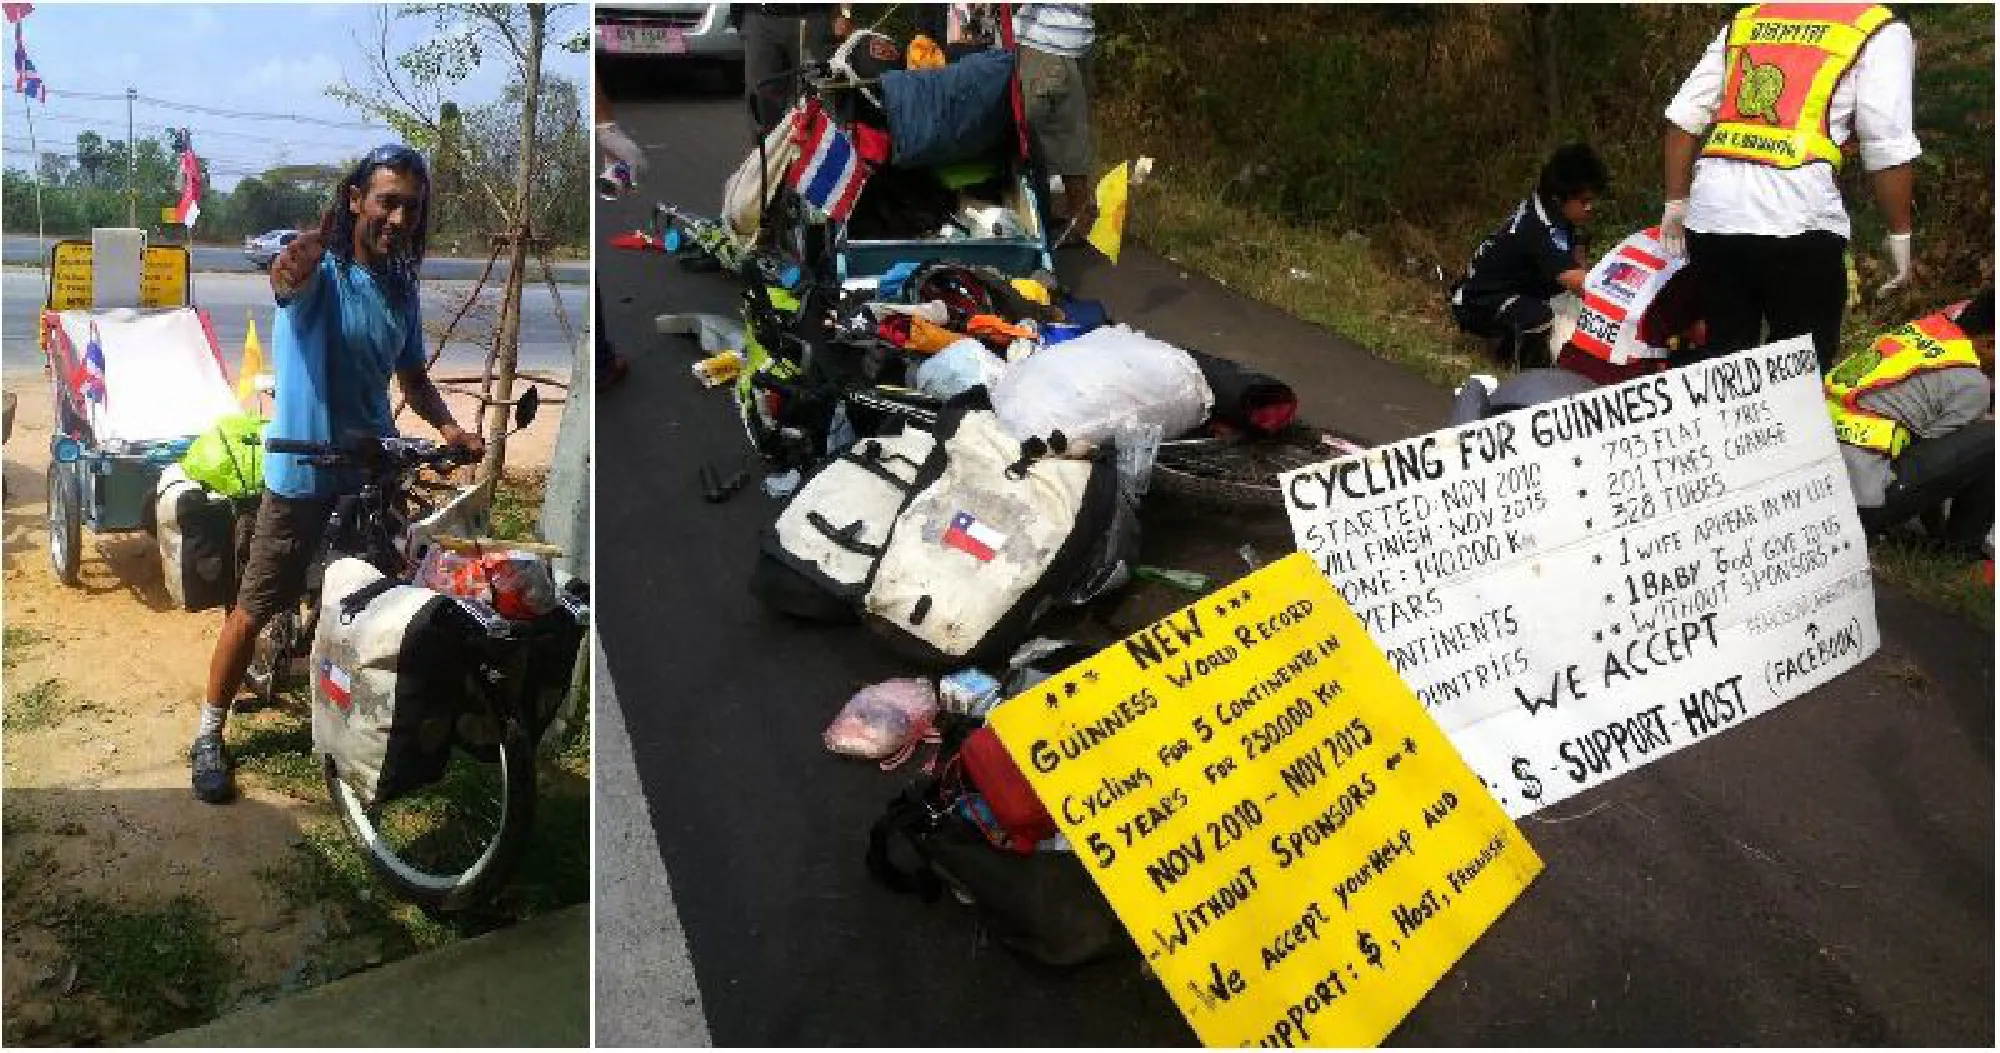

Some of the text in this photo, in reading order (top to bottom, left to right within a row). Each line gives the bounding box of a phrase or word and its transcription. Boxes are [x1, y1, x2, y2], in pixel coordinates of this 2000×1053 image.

[1290, 437, 1445, 511] CYCLING
[1458, 419, 1517, 471] FOR
[1530, 376, 1673, 449] GUINNESS
[1682, 357, 1763, 408] WORLD
[1601, 433, 1648, 463] 793
[1651, 416, 1702, 452] FLAT
[1606, 463, 1647, 497] 201
[1723, 421, 1787, 461] CHANGE
[1440, 476, 1486, 514] NOV
[1496, 461, 1542, 499] 2010
[1449, 506, 1494, 541] NOV
[1500, 489, 1547, 525] 2015
[1610, 471, 1727, 529] 328 TUBES
[1635, 530, 1683, 561] WIFE
[1693, 503, 1759, 546] APPEAR
[1761, 497, 1781, 520] IN
[1641, 559, 1701, 601] BABY
[1763, 530, 1798, 562] GIVE
[1356, 586, 1444, 635] YEARS
[1629, 579, 1729, 635] WITHOUT
[1741, 544, 1829, 596] SPONSORS
[1124, 605, 1206, 671] NEW
[1514, 612, 1719, 716] WE ACCEPT
[1764, 615, 1863, 698] (FACEBOOK)
[1029, 598, 1314, 775] GUINNESS WORLD RECORD
[1190, 713, 1215, 745] 5
[1085, 832, 1115, 871] 5
[1115, 786, 1189, 849] YEARS
[1144, 832, 1207, 894] NOV
[1205, 798, 1264, 853] 2010
[1278, 746, 1327, 798] NOV
[1322, 715, 1374, 768] 2015
[1269, 772, 1378, 869] SPONSORS
